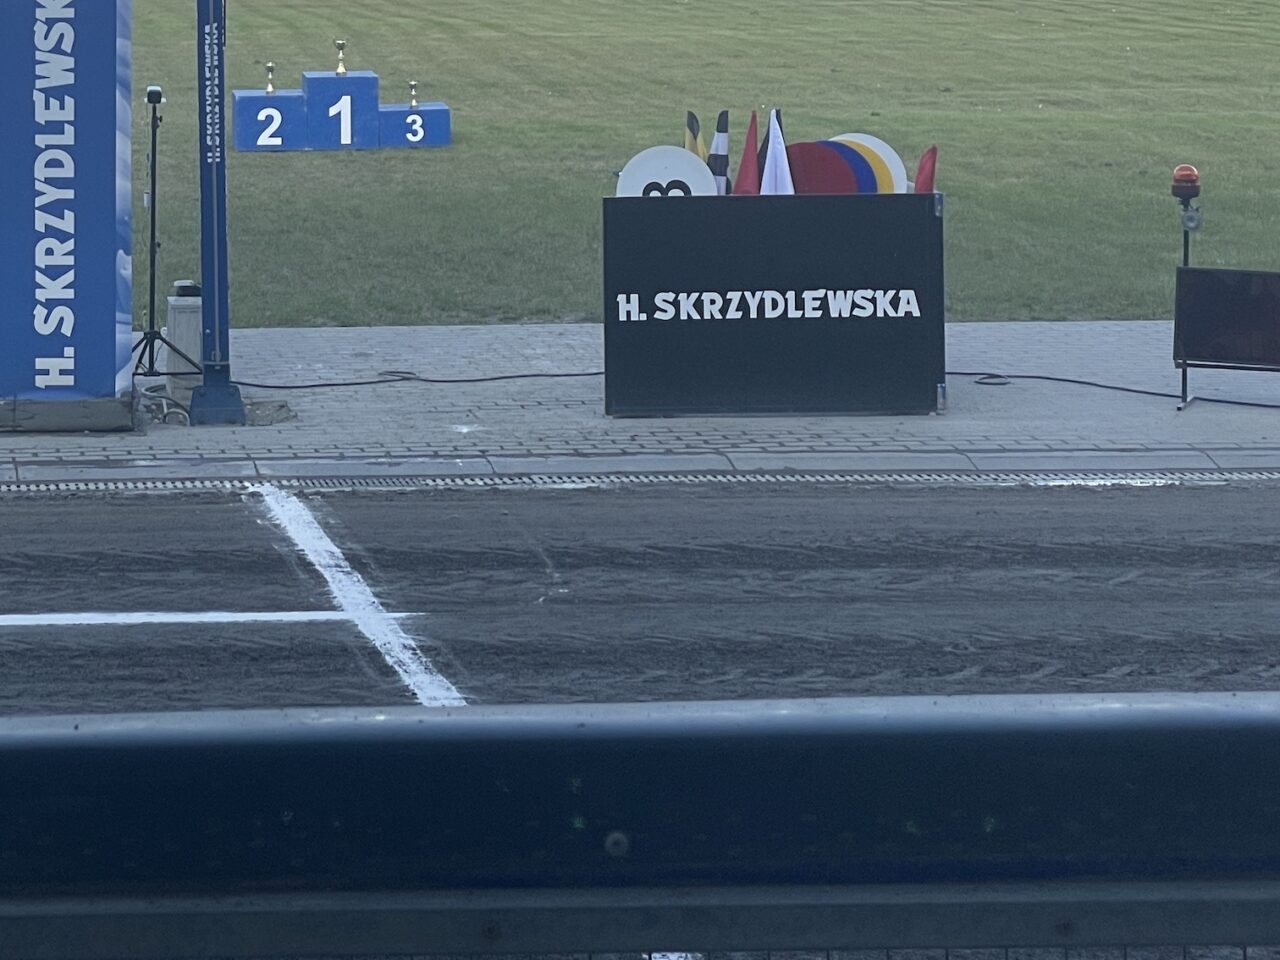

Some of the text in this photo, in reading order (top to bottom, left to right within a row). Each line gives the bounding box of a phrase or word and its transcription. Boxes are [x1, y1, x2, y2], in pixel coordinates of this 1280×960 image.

[256, 108, 283, 146] 2
[328, 95, 352, 144] 1
[405, 114, 425, 141] 3
[616, 288, 921, 321] H. SKRZYDLEWSKA
[34, 346, 75, 389] H.
